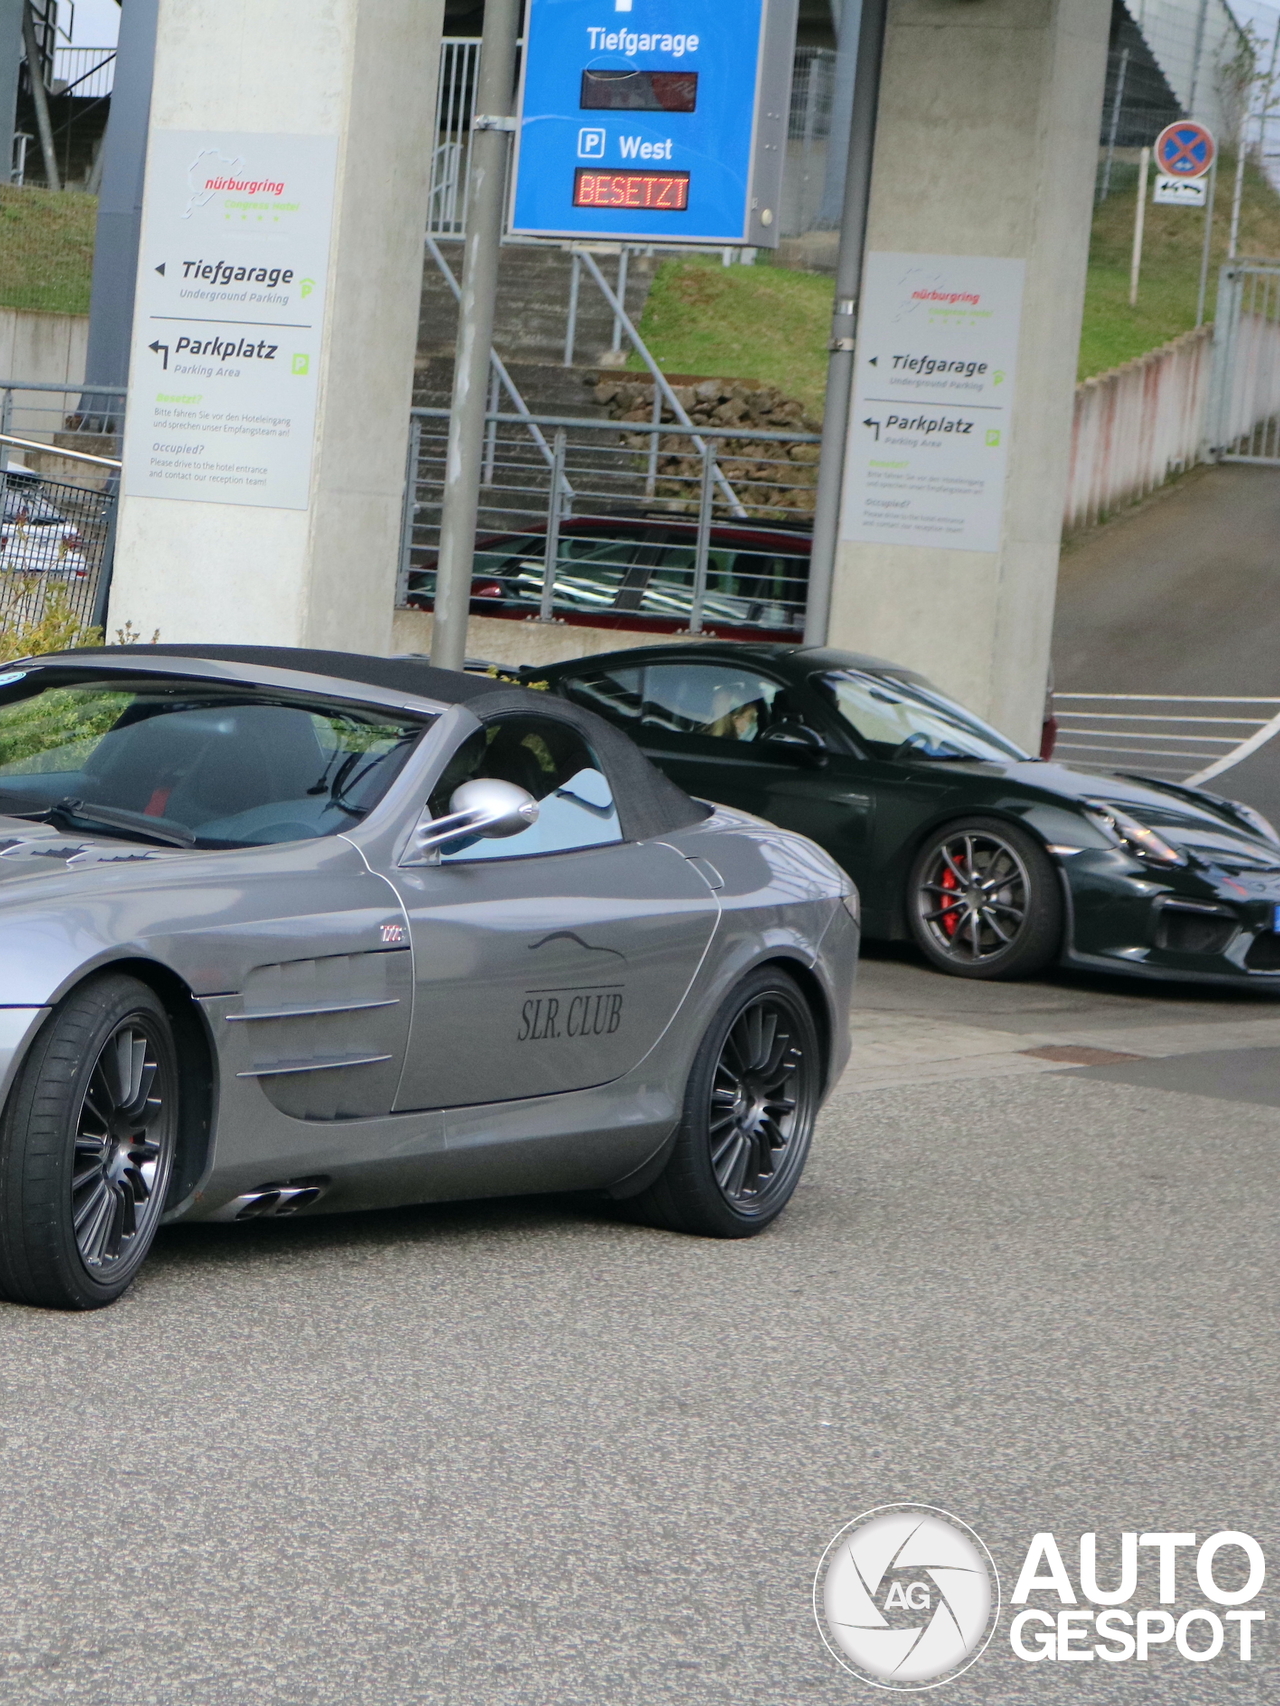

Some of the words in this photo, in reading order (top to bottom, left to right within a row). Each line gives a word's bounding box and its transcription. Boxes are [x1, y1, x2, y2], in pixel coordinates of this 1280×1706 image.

[586, 27, 700, 57] Tiefgarage
[619, 136, 673, 160] West
[205, 176, 285, 196] nürburgring
[578, 175, 689, 207] BESETZT
[224, 199, 269, 211] Congress
[182, 259, 294, 288] Tiefgarage
[180, 288, 247, 302] Underground
[249, 292, 290, 306] Parking
[911, 289, 981, 305] nürburgring
[175, 336, 278, 361] Parkplatz
[174, 364, 213, 378] Parking
[215, 367, 240, 378] Area
[892, 354, 988, 377] Tiefgarage
[154, 407, 171, 417] Bitte
[173, 408, 196, 419] fahren
[199, 410, 209, 419] Sie
[225, 413, 239, 421] den
[241, 413, 291, 427] Hoteleingang
[886, 415, 974, 435] Parkplatz
[153, 420, 167, 428] und
[168, 421, 200, 430] sprechen
[223, 424, 277, 437] Empfangsteam
[152, 442, 205, 455] Occupied?
[150, 457, 173, 467] Please
[174, 459, 192, 468] drive
[202, 461, 214, 470] the
[216, 462, 235, 472] hotel
[236, 466, 268, 474] entrance
[149, 470, 163, 478] and
[165, 472, 191, 480] contact
[209, 475, 243, 485] reception
[246, 477, 267, 486] team!
[567, 993, 624, 1037] CLUB
